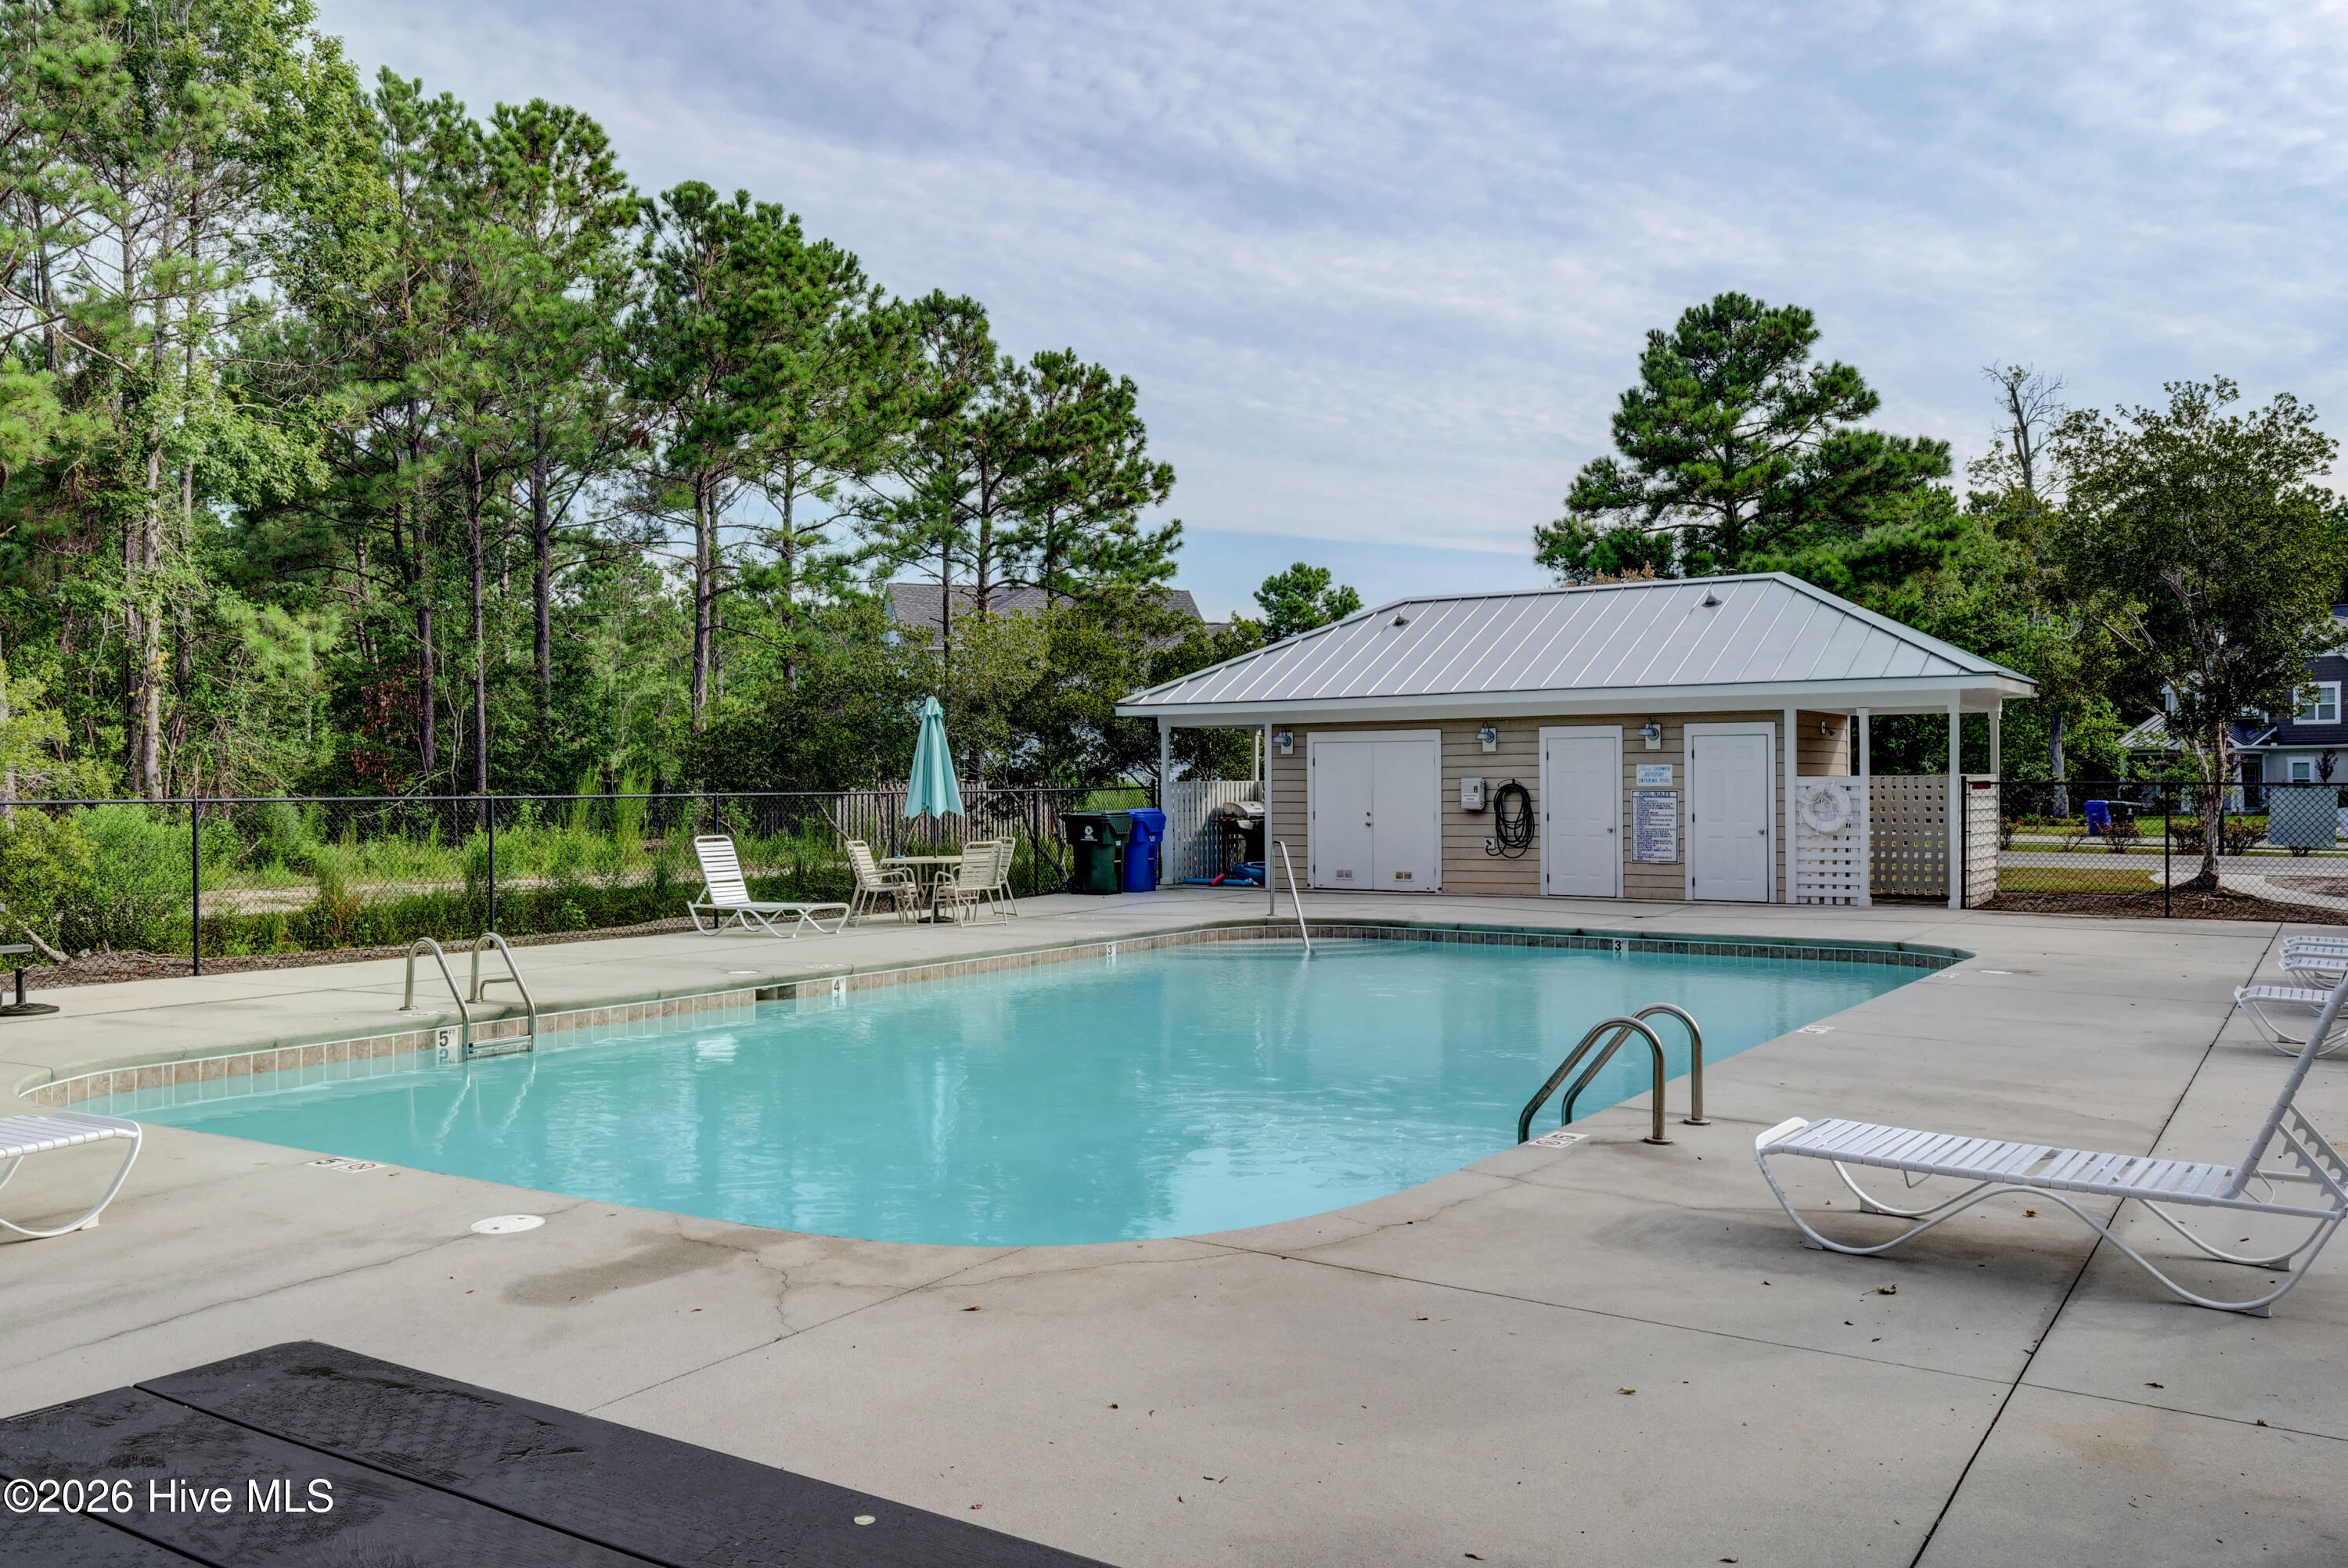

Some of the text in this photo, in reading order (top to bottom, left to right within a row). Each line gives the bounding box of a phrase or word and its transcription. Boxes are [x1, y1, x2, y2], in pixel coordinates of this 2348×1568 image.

[1107, 944, 1112, 955] 3
[1615, 940, 1622, 951] 3
[834, 980, 841, 992] 4
[439, 1030, 448, 1047] 5
